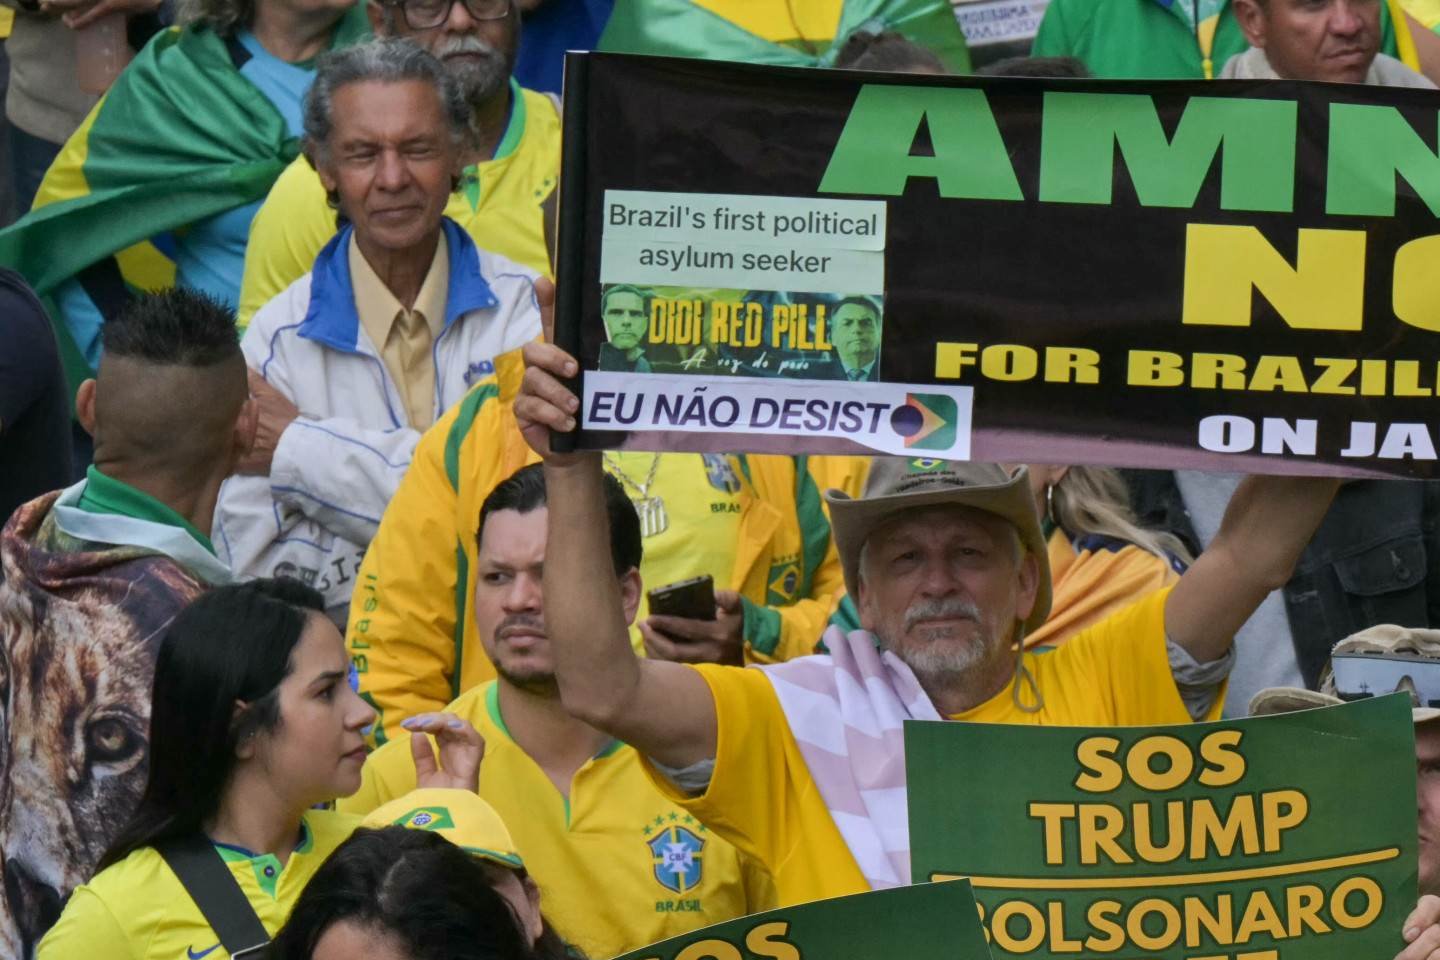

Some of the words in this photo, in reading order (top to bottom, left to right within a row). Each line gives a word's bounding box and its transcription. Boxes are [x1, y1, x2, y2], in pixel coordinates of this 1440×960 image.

[608, 203, 706, 229] Brazil's
[713, 207, 766, 231] first
[773, 211, 878, 237] political
[638, 245, 734, 272] asylum
[741, 250, 832, 274] seeker
[648, 298, 704, 345] DIDI
[710, 300, 763, 348] RED
[771, 303, 833, 351] PILL
[935, 342, 1100, 384] FOR
[588, 391, 642, 423] EU
[651, 386, 740, 429] NÃO
[1198, 415, 1318, 456] ON
[1074, 729, 1247, 793] SOS
[1029, 789, 1308, 866] TRUMP
[655, 899, 704, 913] BRASIL
